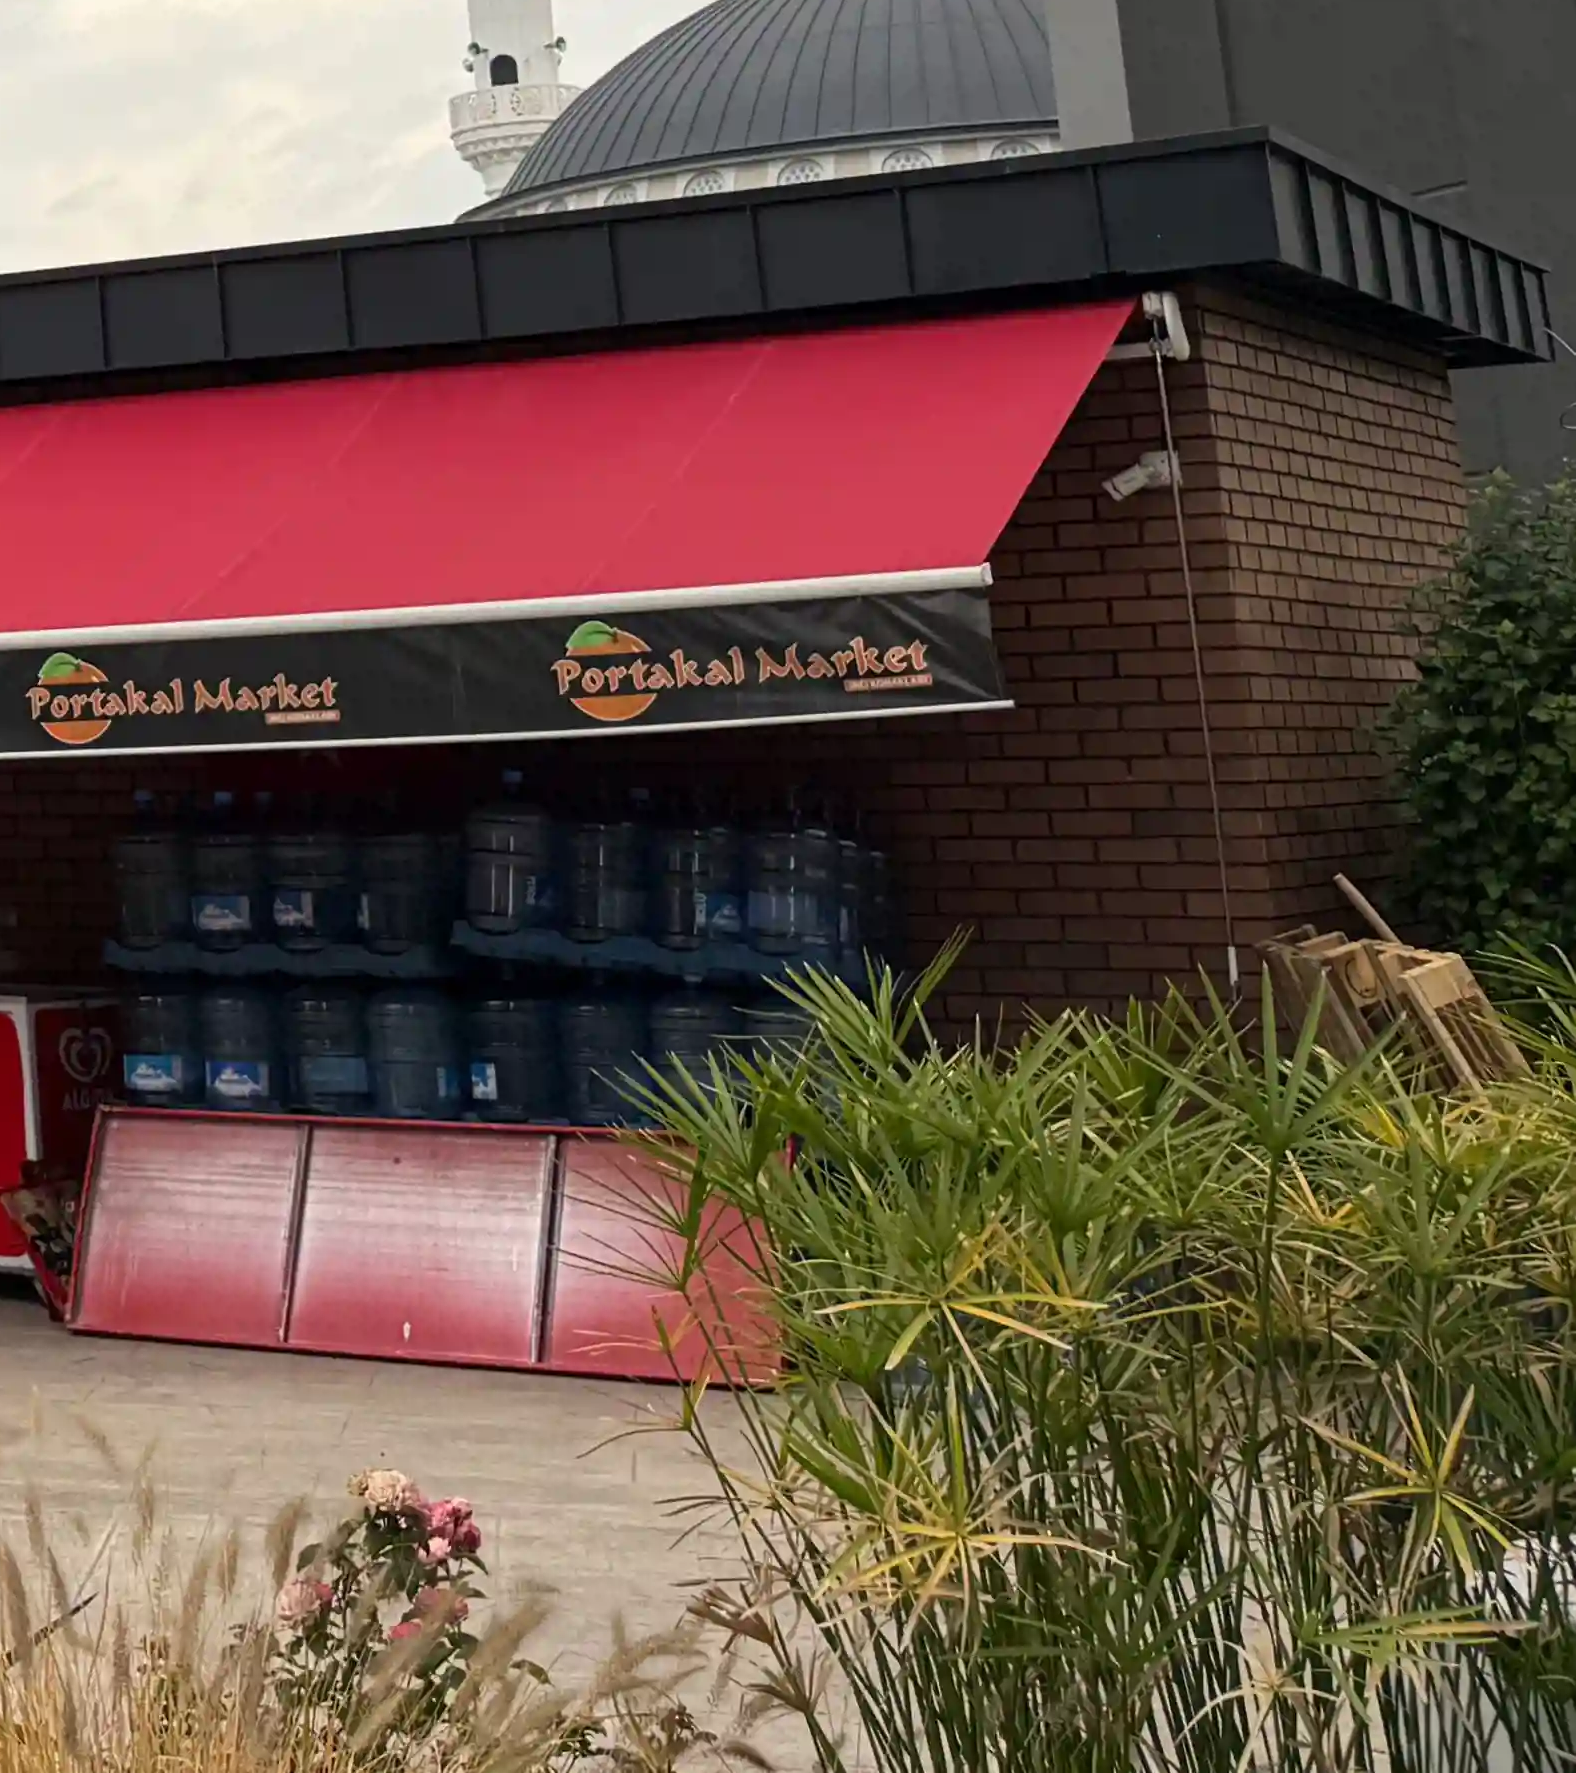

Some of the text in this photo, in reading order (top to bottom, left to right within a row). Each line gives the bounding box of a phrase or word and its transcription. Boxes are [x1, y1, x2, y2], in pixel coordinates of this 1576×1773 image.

[550, 635, 929, 696] Portakal Market
[25, 672, 339, 720] Portakal Market
